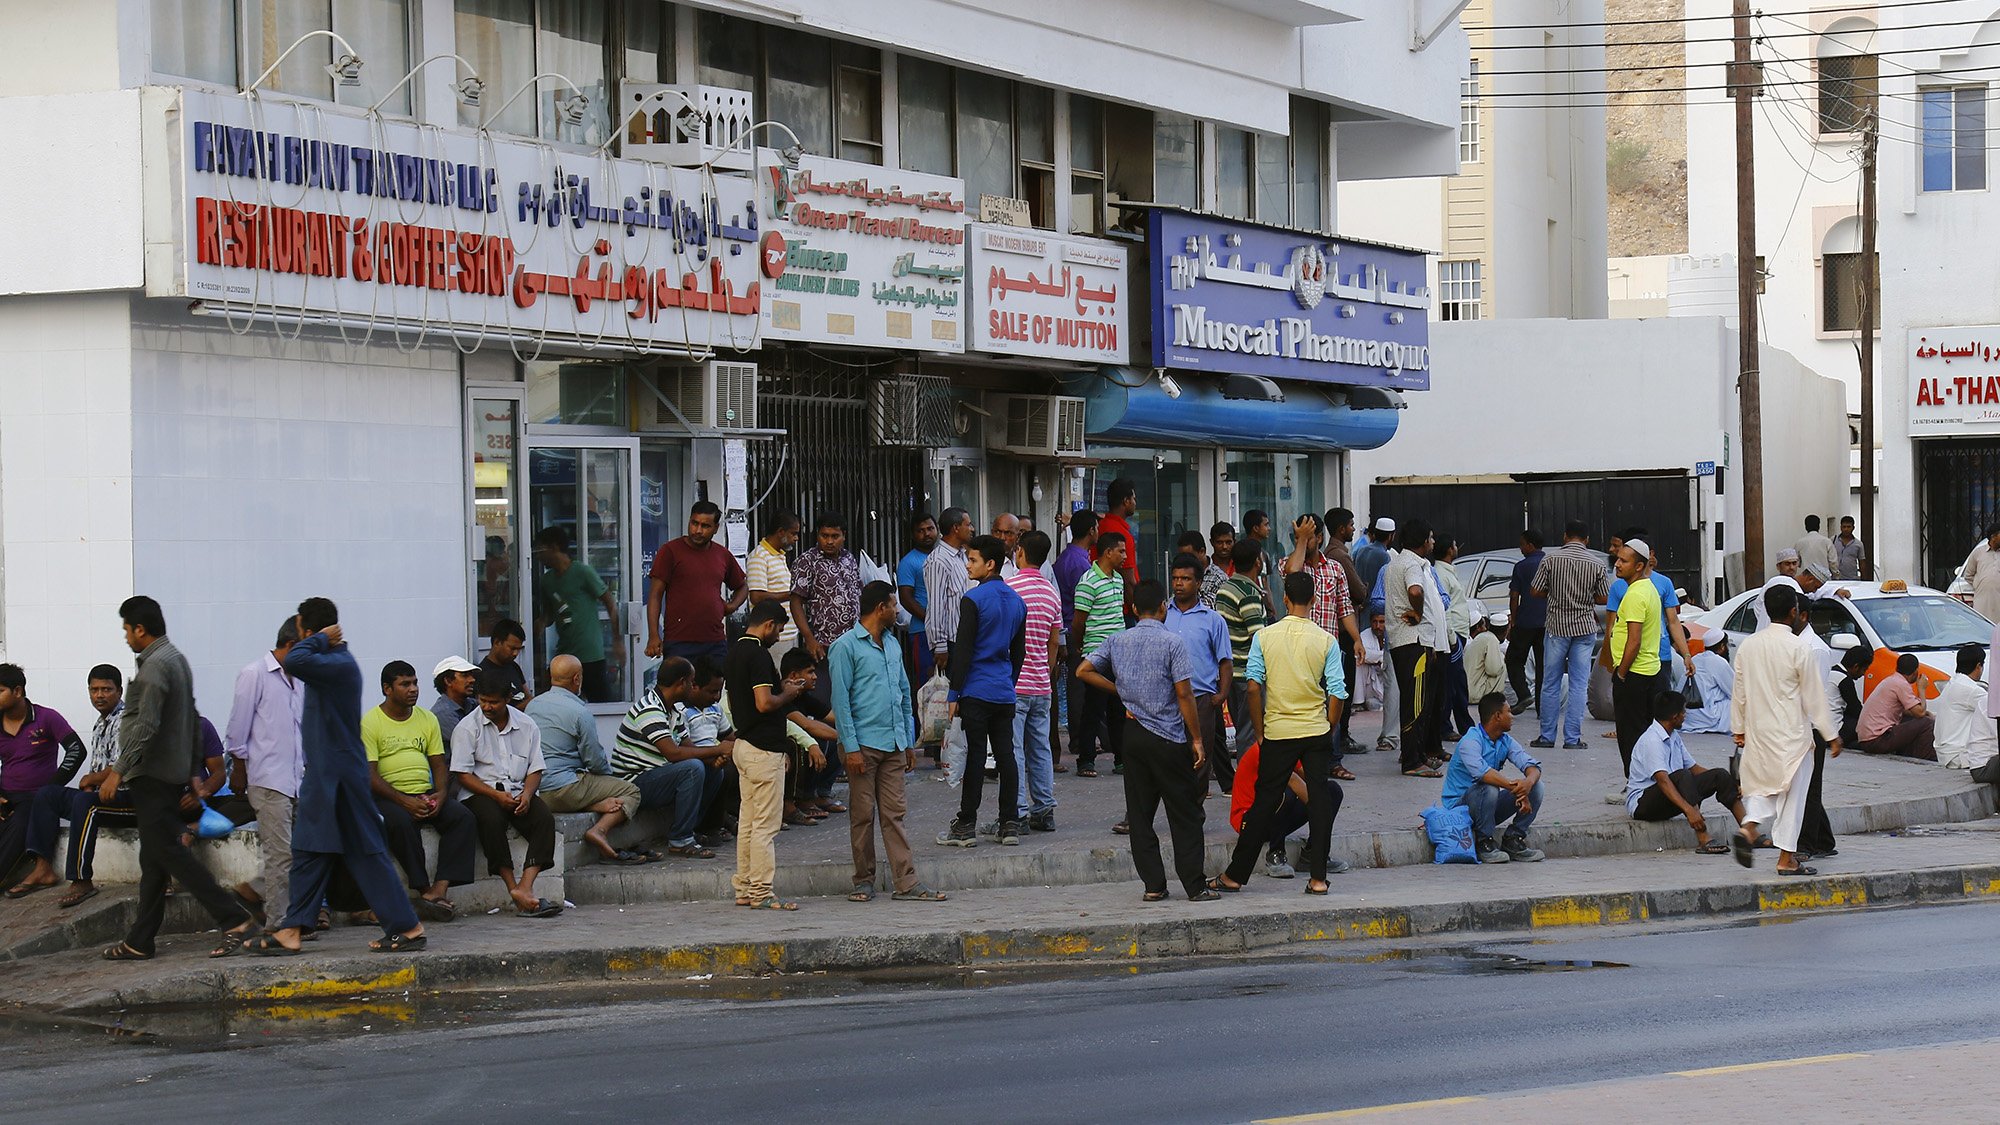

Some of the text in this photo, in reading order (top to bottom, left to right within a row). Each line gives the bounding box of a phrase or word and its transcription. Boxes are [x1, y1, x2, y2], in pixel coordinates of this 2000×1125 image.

[351, 147, 456, 207] TRADING
[457, 163, 499, 213] LLC
[196, 197, 514, 297] RESTAURANT & COFFEE SHOP
[791, 202, 848, 231] Oman
[849, 210, 904, 239] Travel
[904, 217, 964, 246] Bureau
[785, 240, 848, 272] Biman
[1198, 233, 1297, 291] مسقط
[776, 273, 860, 297] BANGLADESH AIRLINES
[988, 264, 1117, 316] بيع اللحوم
[989, 309, 1118, 351] SALE OF MUTTON
[1172, 303, 1430, 377] Muscat Pharmacy LLC
[1916, 337, 1991, 364] والسياحة
